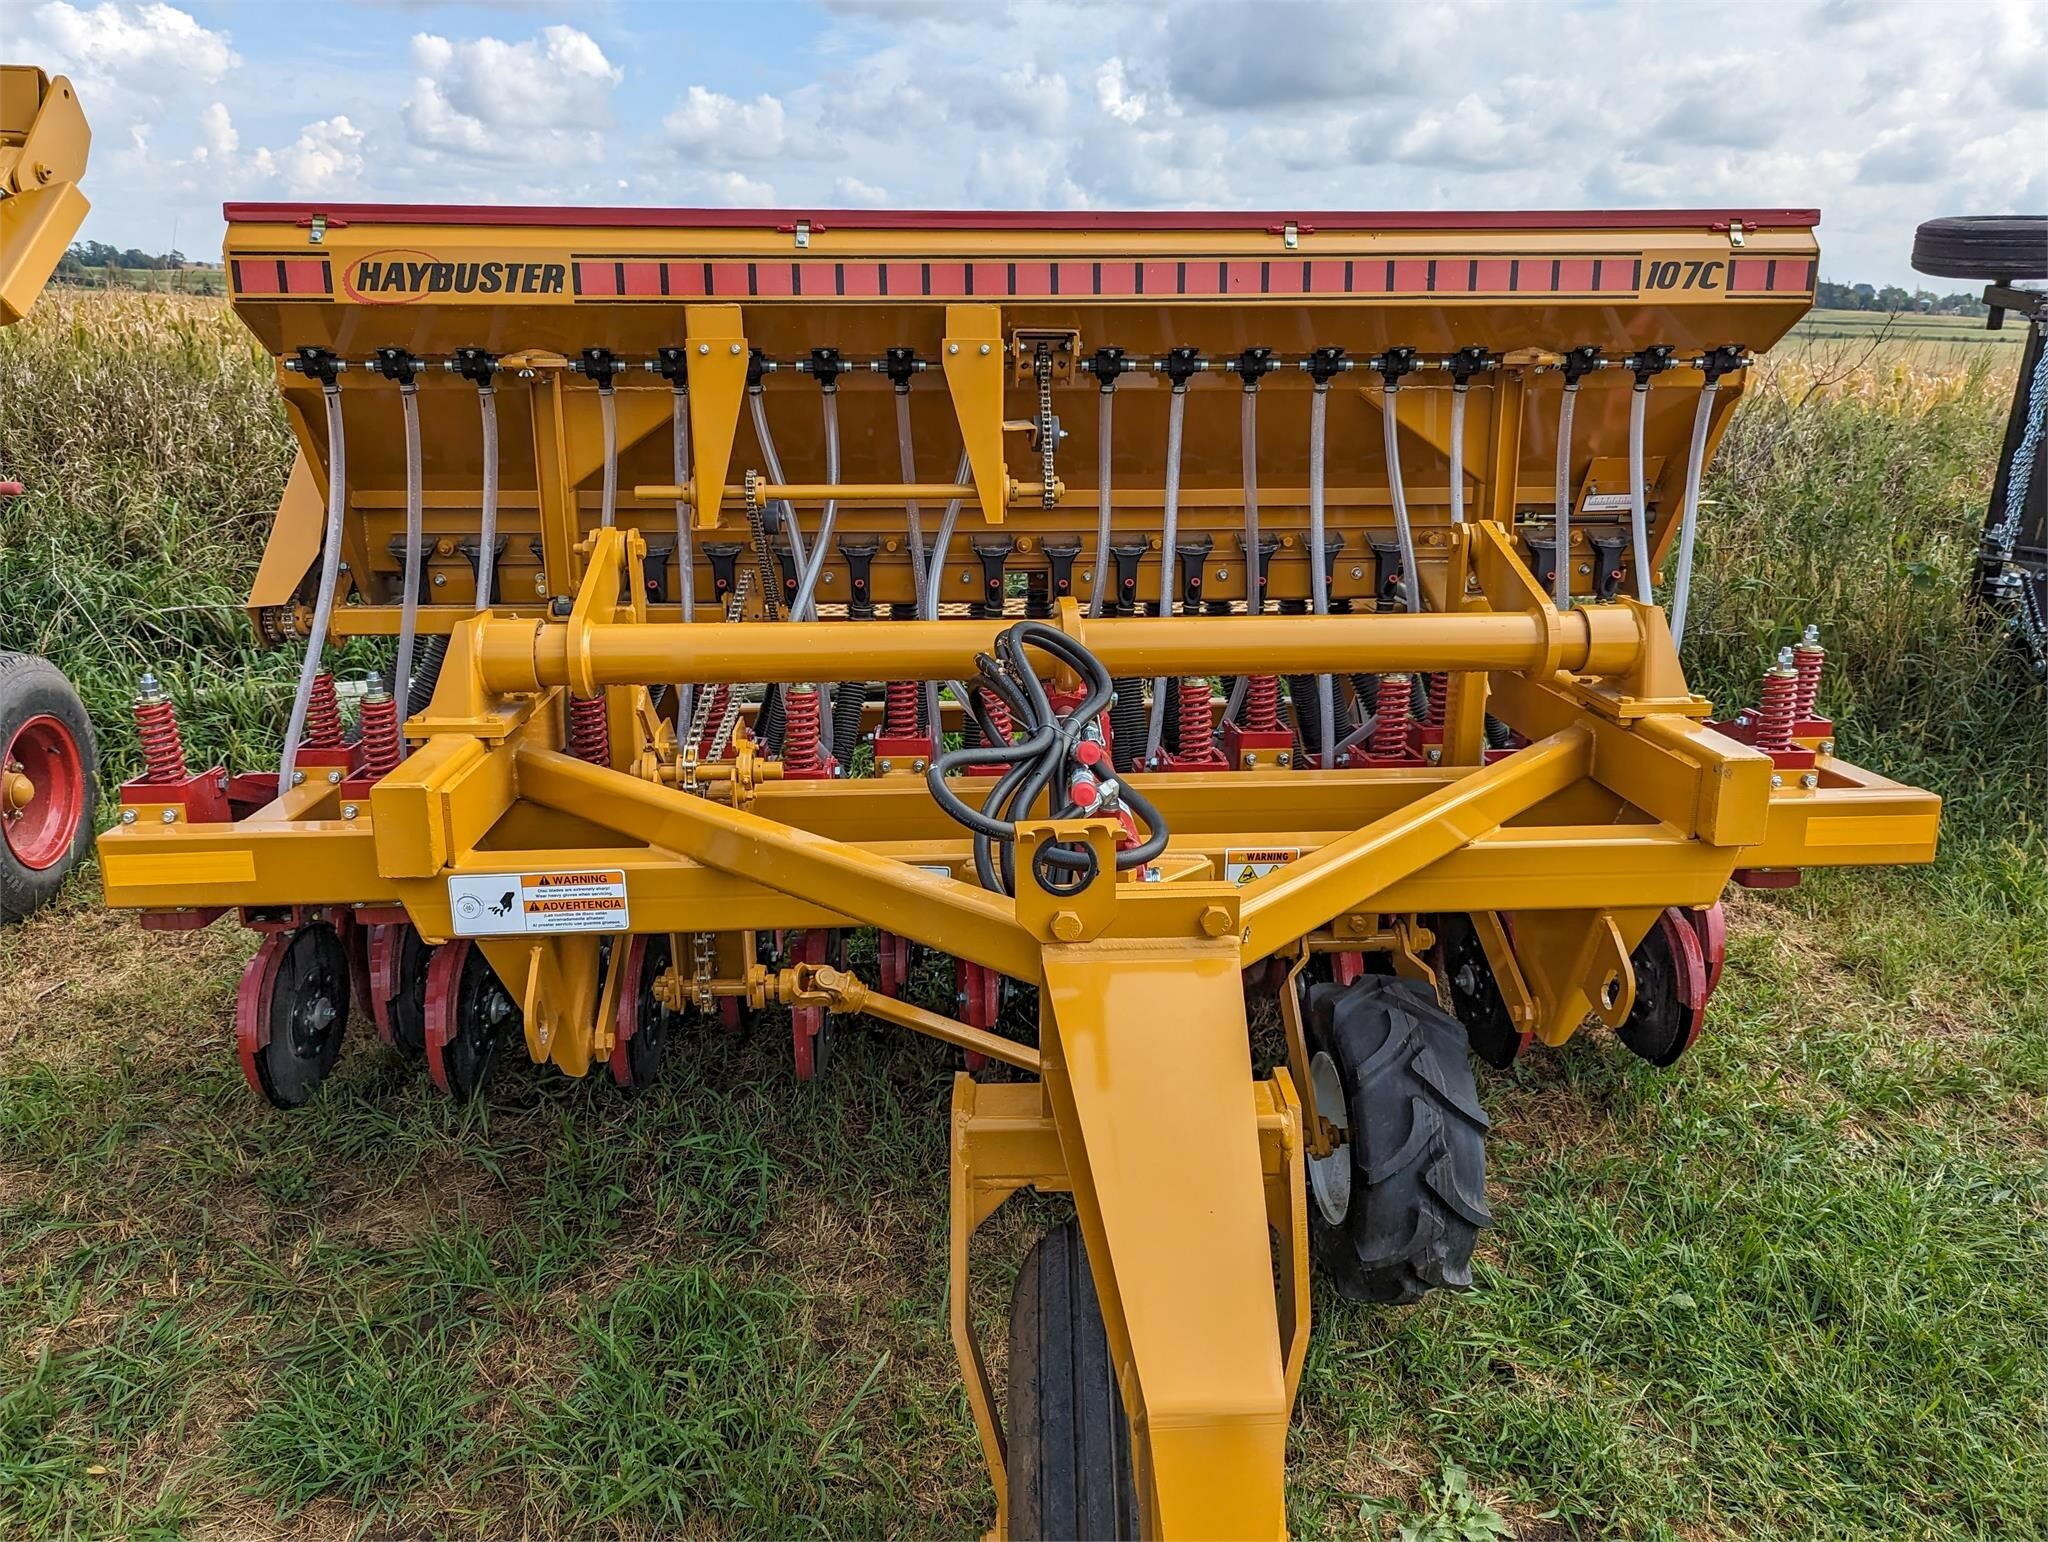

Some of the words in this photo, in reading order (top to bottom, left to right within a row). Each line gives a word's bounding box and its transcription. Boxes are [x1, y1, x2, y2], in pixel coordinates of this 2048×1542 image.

[356, 262, 566, 293] HAYBUSTER
[1645, 261, 1724, 289] 107C
[1246, 852, 1289, 861] WARNING
[552, 874, 608, 885] WARNING
[543, 900, 621, 911] ADVERTENCIA
